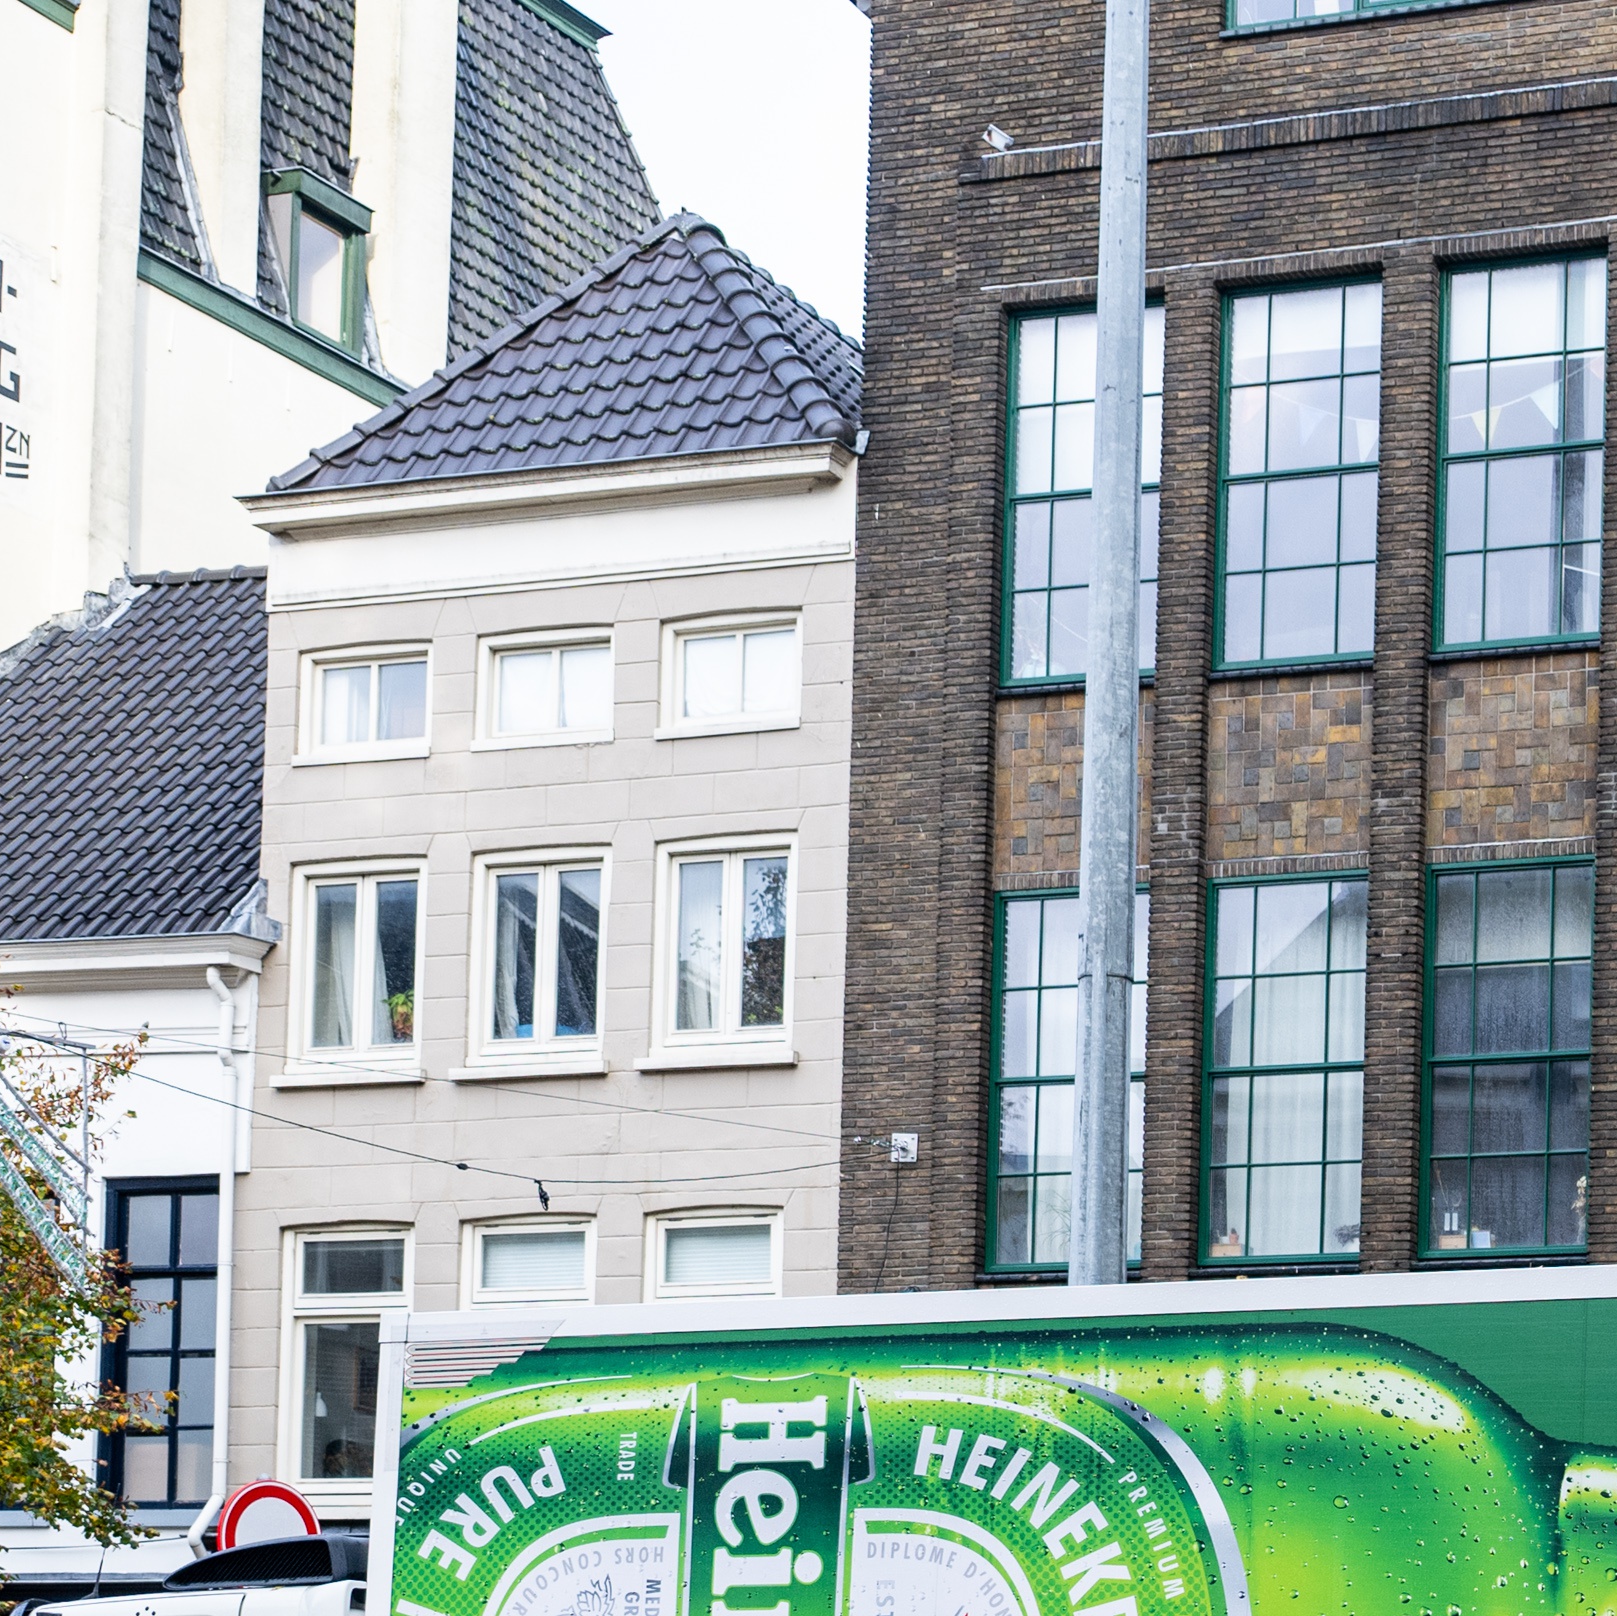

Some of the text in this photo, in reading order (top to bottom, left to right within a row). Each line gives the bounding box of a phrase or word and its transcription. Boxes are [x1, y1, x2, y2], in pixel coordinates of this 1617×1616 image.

[617, 1431, 637, 1481] TRADE
[417, 1445, 566, 1581] PURE
[1118, 1470, 1185, 1599] PREMIUM
[614, 1546, 664, 1564] HORS
[867, 1541, 958, 1570] DIPLOME
